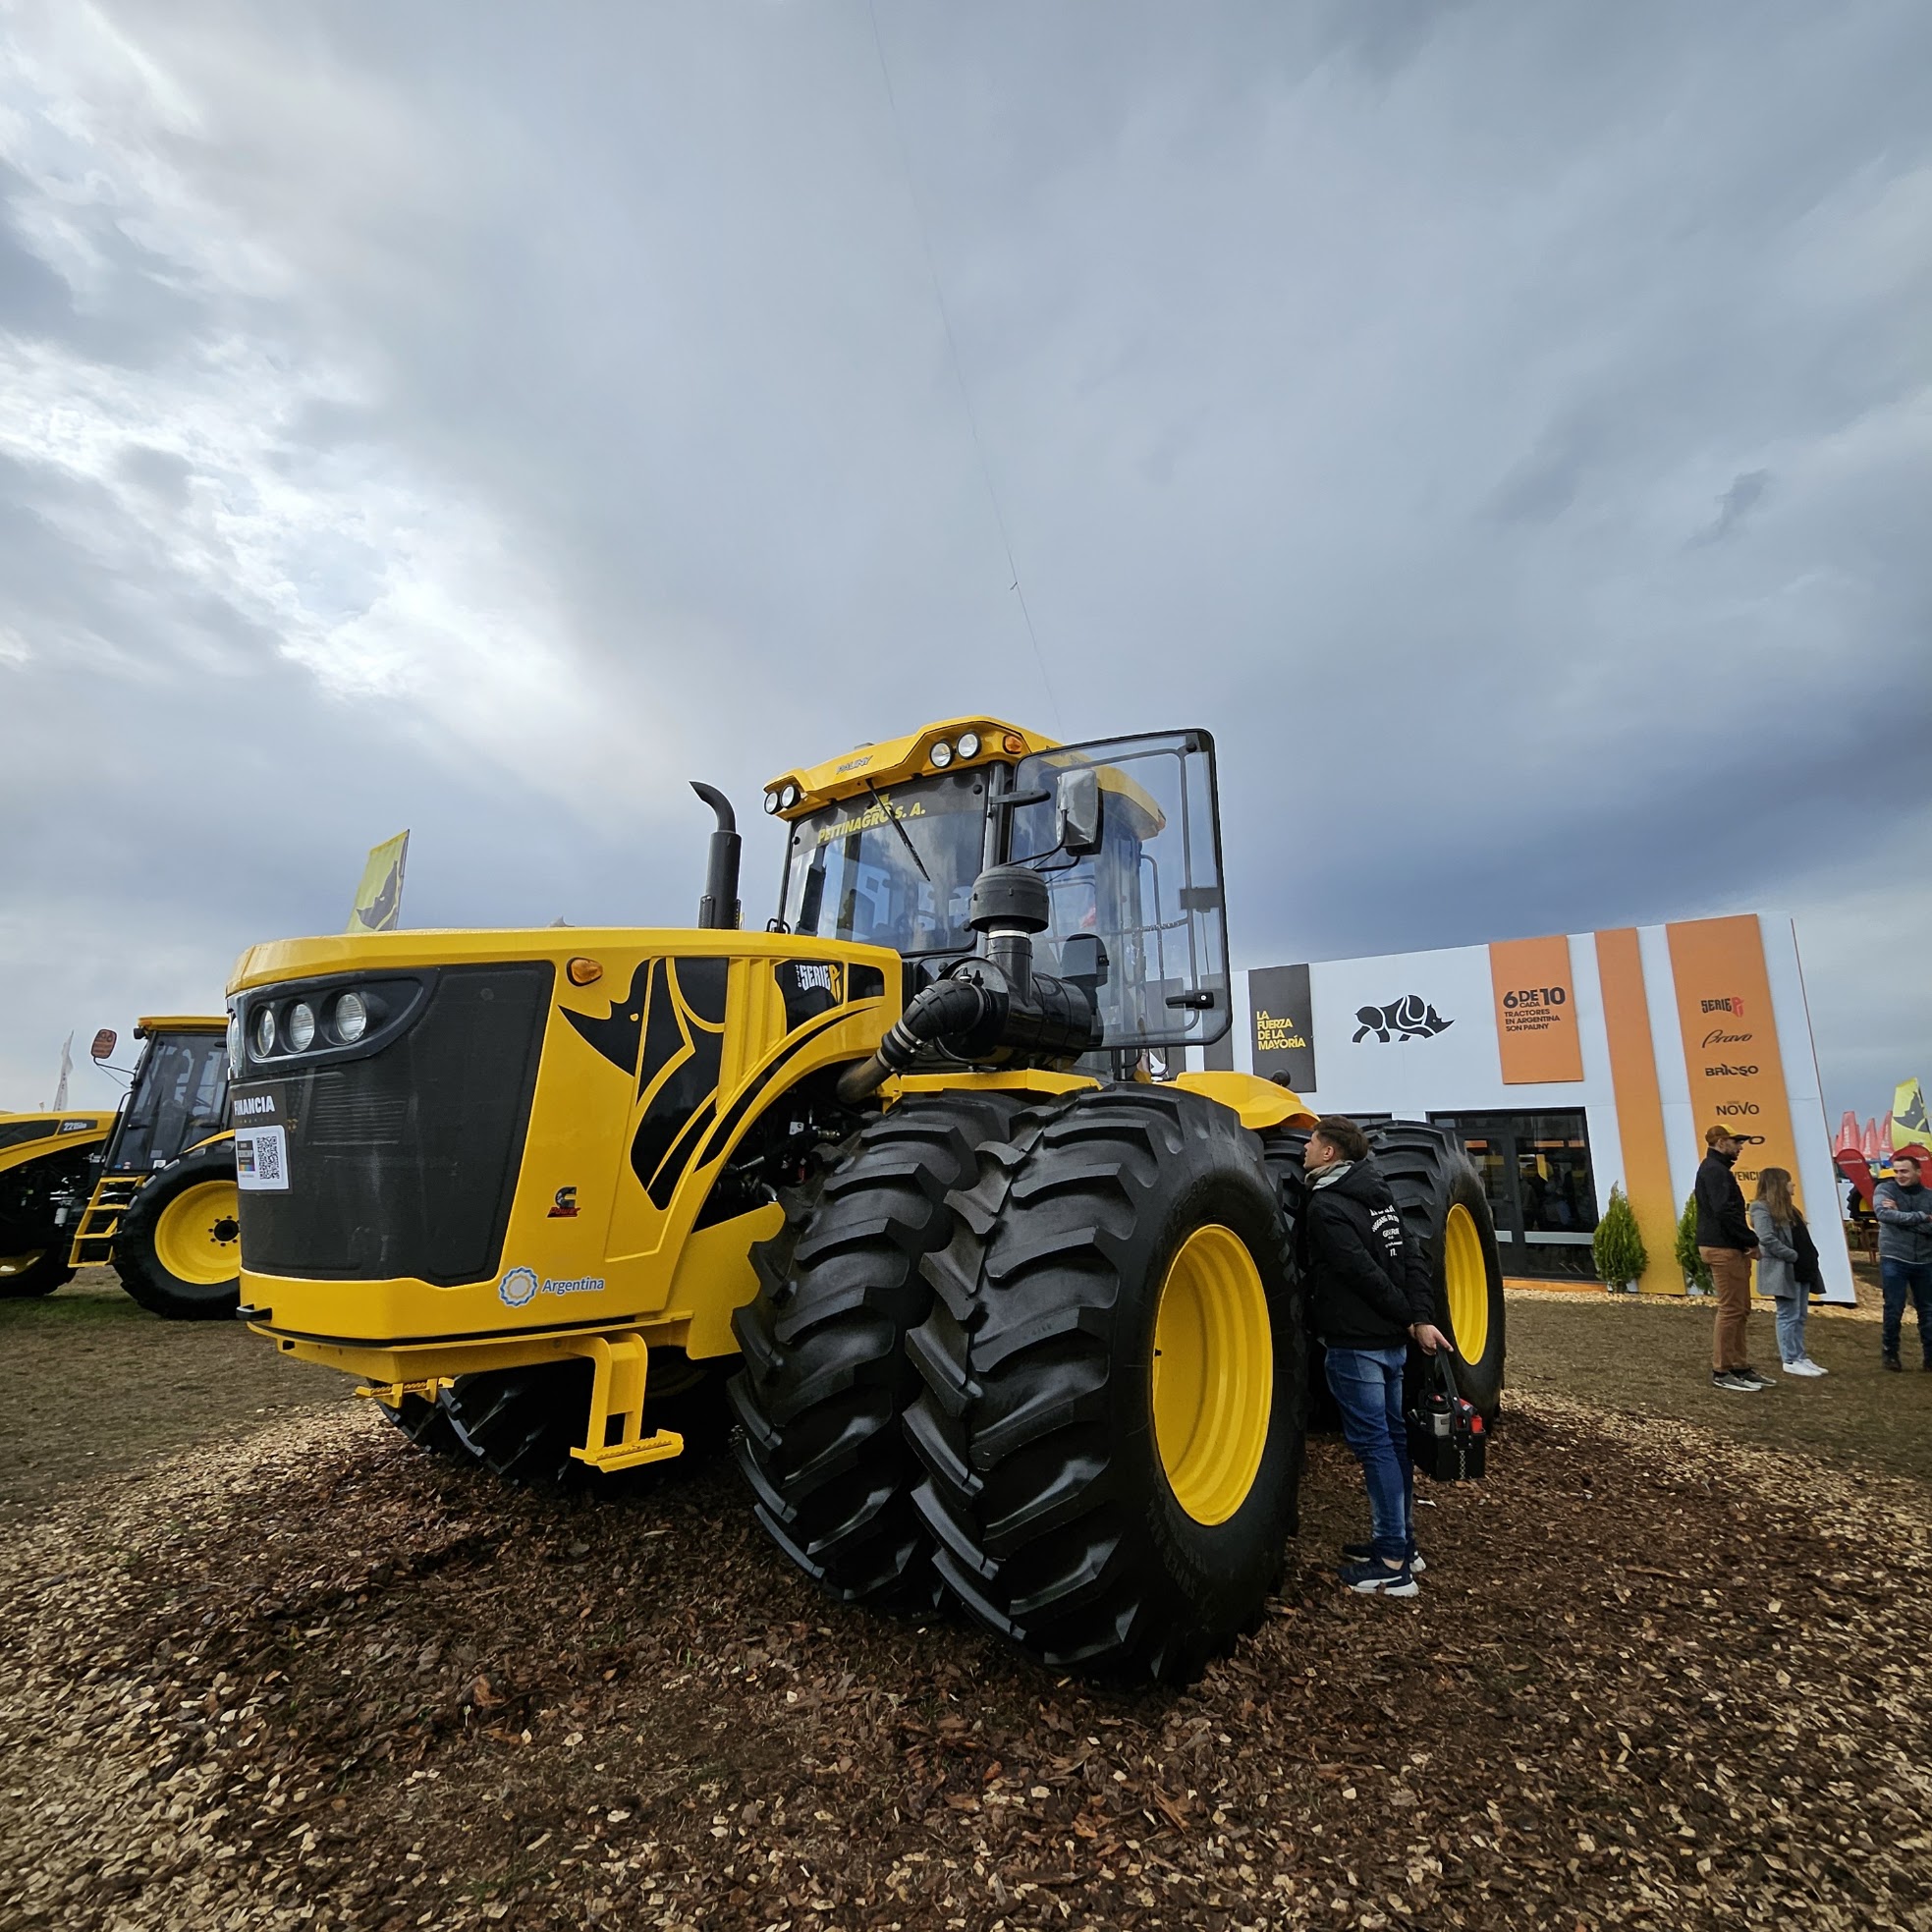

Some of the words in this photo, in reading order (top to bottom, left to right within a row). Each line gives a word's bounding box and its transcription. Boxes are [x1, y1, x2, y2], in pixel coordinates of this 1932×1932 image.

[800, 965, 831, 990] SERIE
[1503, 990, 1518, 1009] 6
[1518, 989, 1539, 1002] DE
[1539, 986, 1566, 1006] 10
[1504, 1008, 1550, 1018] TRACTORES
[1701, 998, 1732, 1014] SERIE
[1256, 1010, 1270, 1021] LA
[1517, 1015, 1561, 1023] ARGENTINA
[1257, 1018, 1294, 1030] FUERZA
[1257, 1030, 1271, 1040] DE
[1271, 1029, 1285, 1039] LA
[1701, 1029, 1753, 1048] Bravo
[1258, 1034, 1306, 1051] MAYORÍA
[1716, 1102, 1760, 1116] NOVO
[542, 1277, 605, 1296] Argentina
